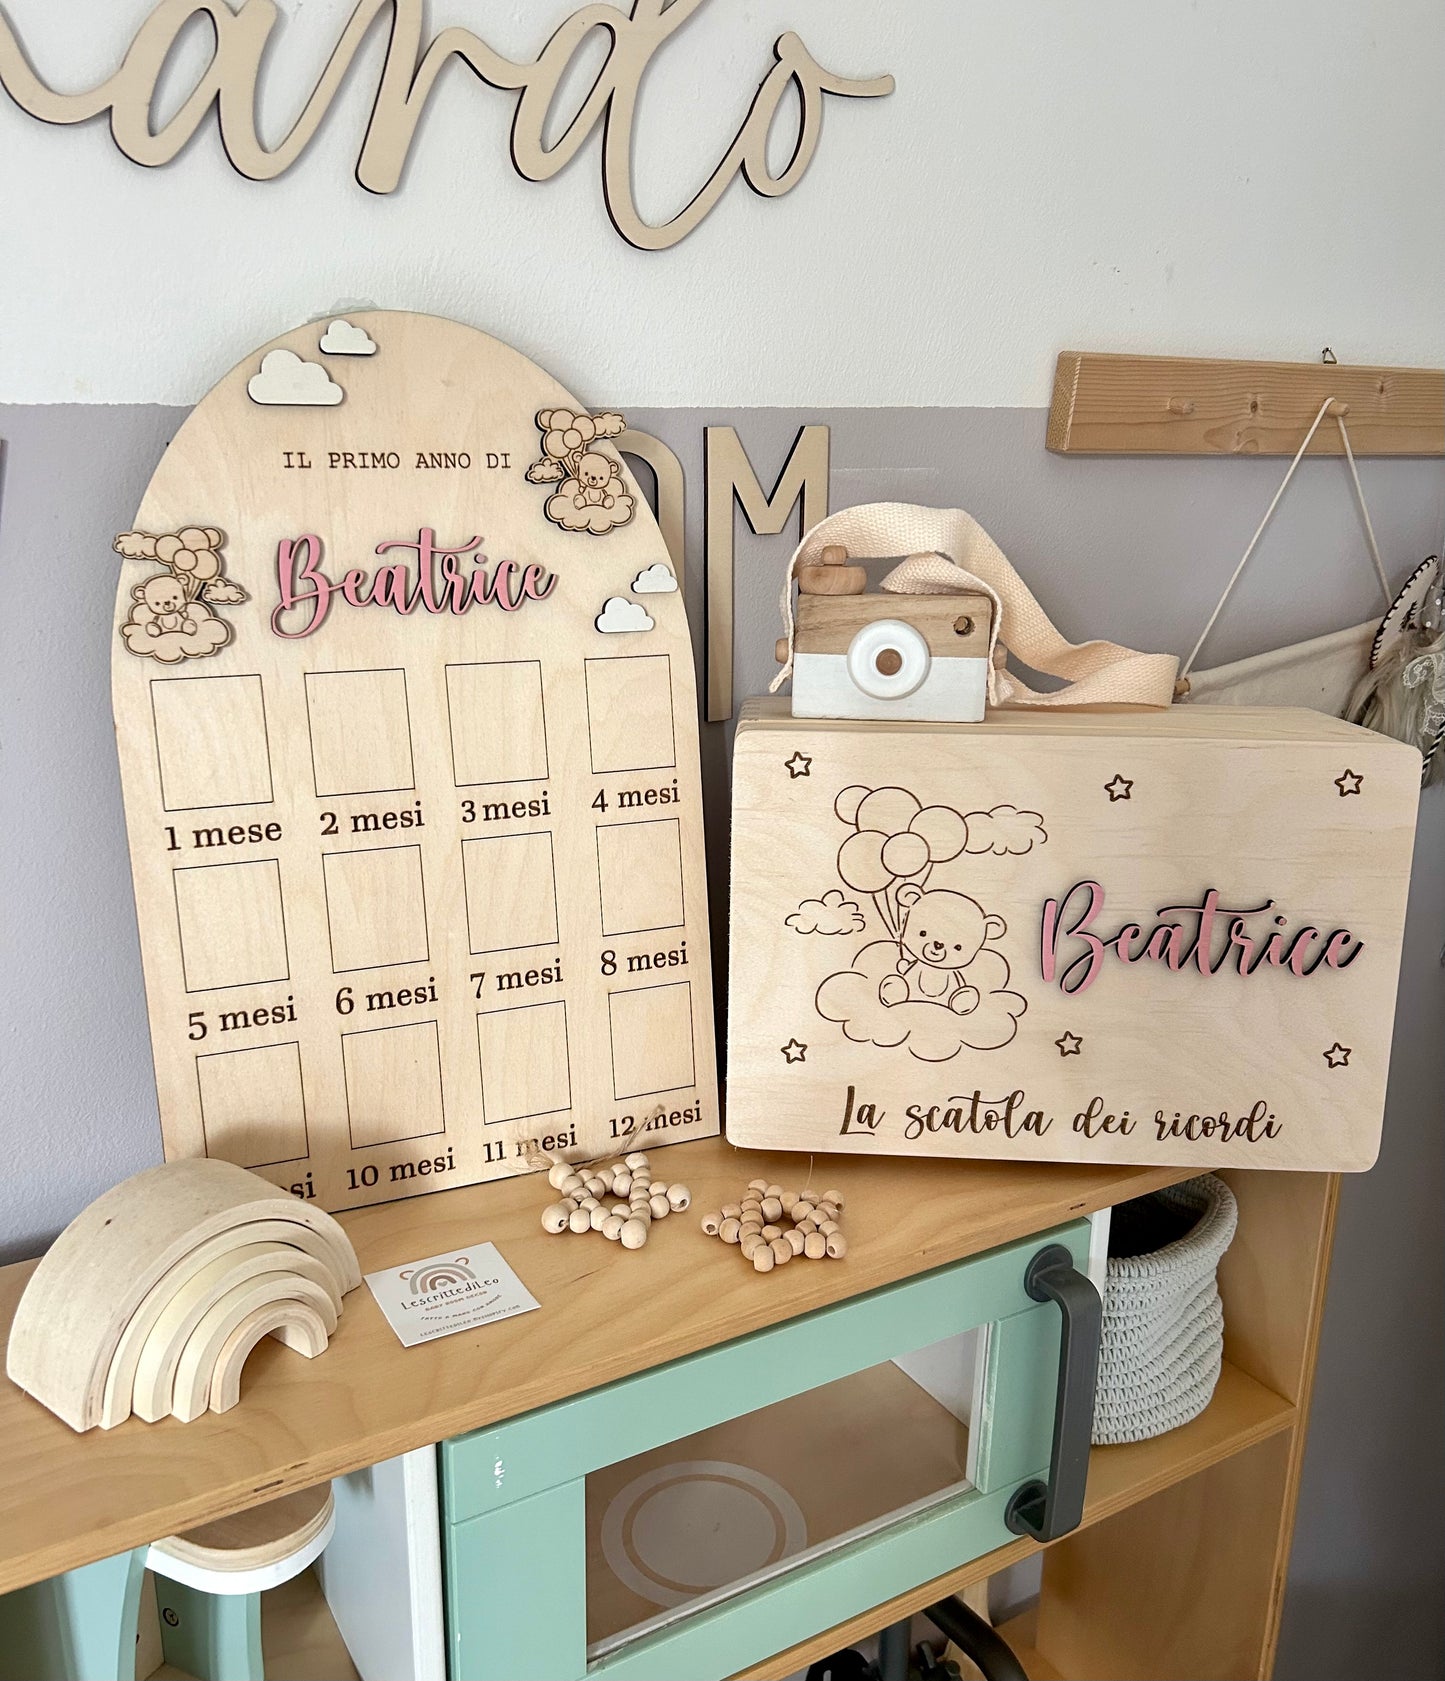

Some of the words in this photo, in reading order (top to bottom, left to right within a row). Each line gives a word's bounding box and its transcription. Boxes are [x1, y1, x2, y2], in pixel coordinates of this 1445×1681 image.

[282, 451, 312, 470] IL
[327, 451, 400, 470] PRIMO
[415, 451, 471, 470] ANNO
[485, 451, 511, 470] DI
[270, 527, 558, 640] Beatrice
[461, 799, 476, 823] 3
[482, 790, 552, 822] mesi
[591, 788, 609, 813] 4
[617, 778, 681, 809] mesi
[164, 826, 182, 851] 1
[192, 821, 282, 849] mese
[319, 811, 339, 836] 2
[350, 800, 426, 834] mesi
[1040, 880, 1364, 996] Beatrice
[600, 949, 617, 976] 8
[626, 940, 689, 973] mesi
[335, 986, 355, 1015] 6
[365, 976, 439, 1012] mesi
[470, 972, 486, 999] 7
[495, 957, 564, 991] mesi
[188, 1011, 208, 1041] 5
[218, 995, 298, 1032] mesi
[609, 1115, 637, 1139] 12
[645, 1099, 703, 1132] mesi
[839, 1085, 886, 1137] La
[904, 1089, 1054, 1140] scatola
[1072, 1096, 1137, 1139] dei
[1154, 1100, 1283, 1143] ricordi
[346, 1165, 379, 1190] 10
[388, 1146, 456, 1184] mesi
[482, 1140, 507, 1164] 11
